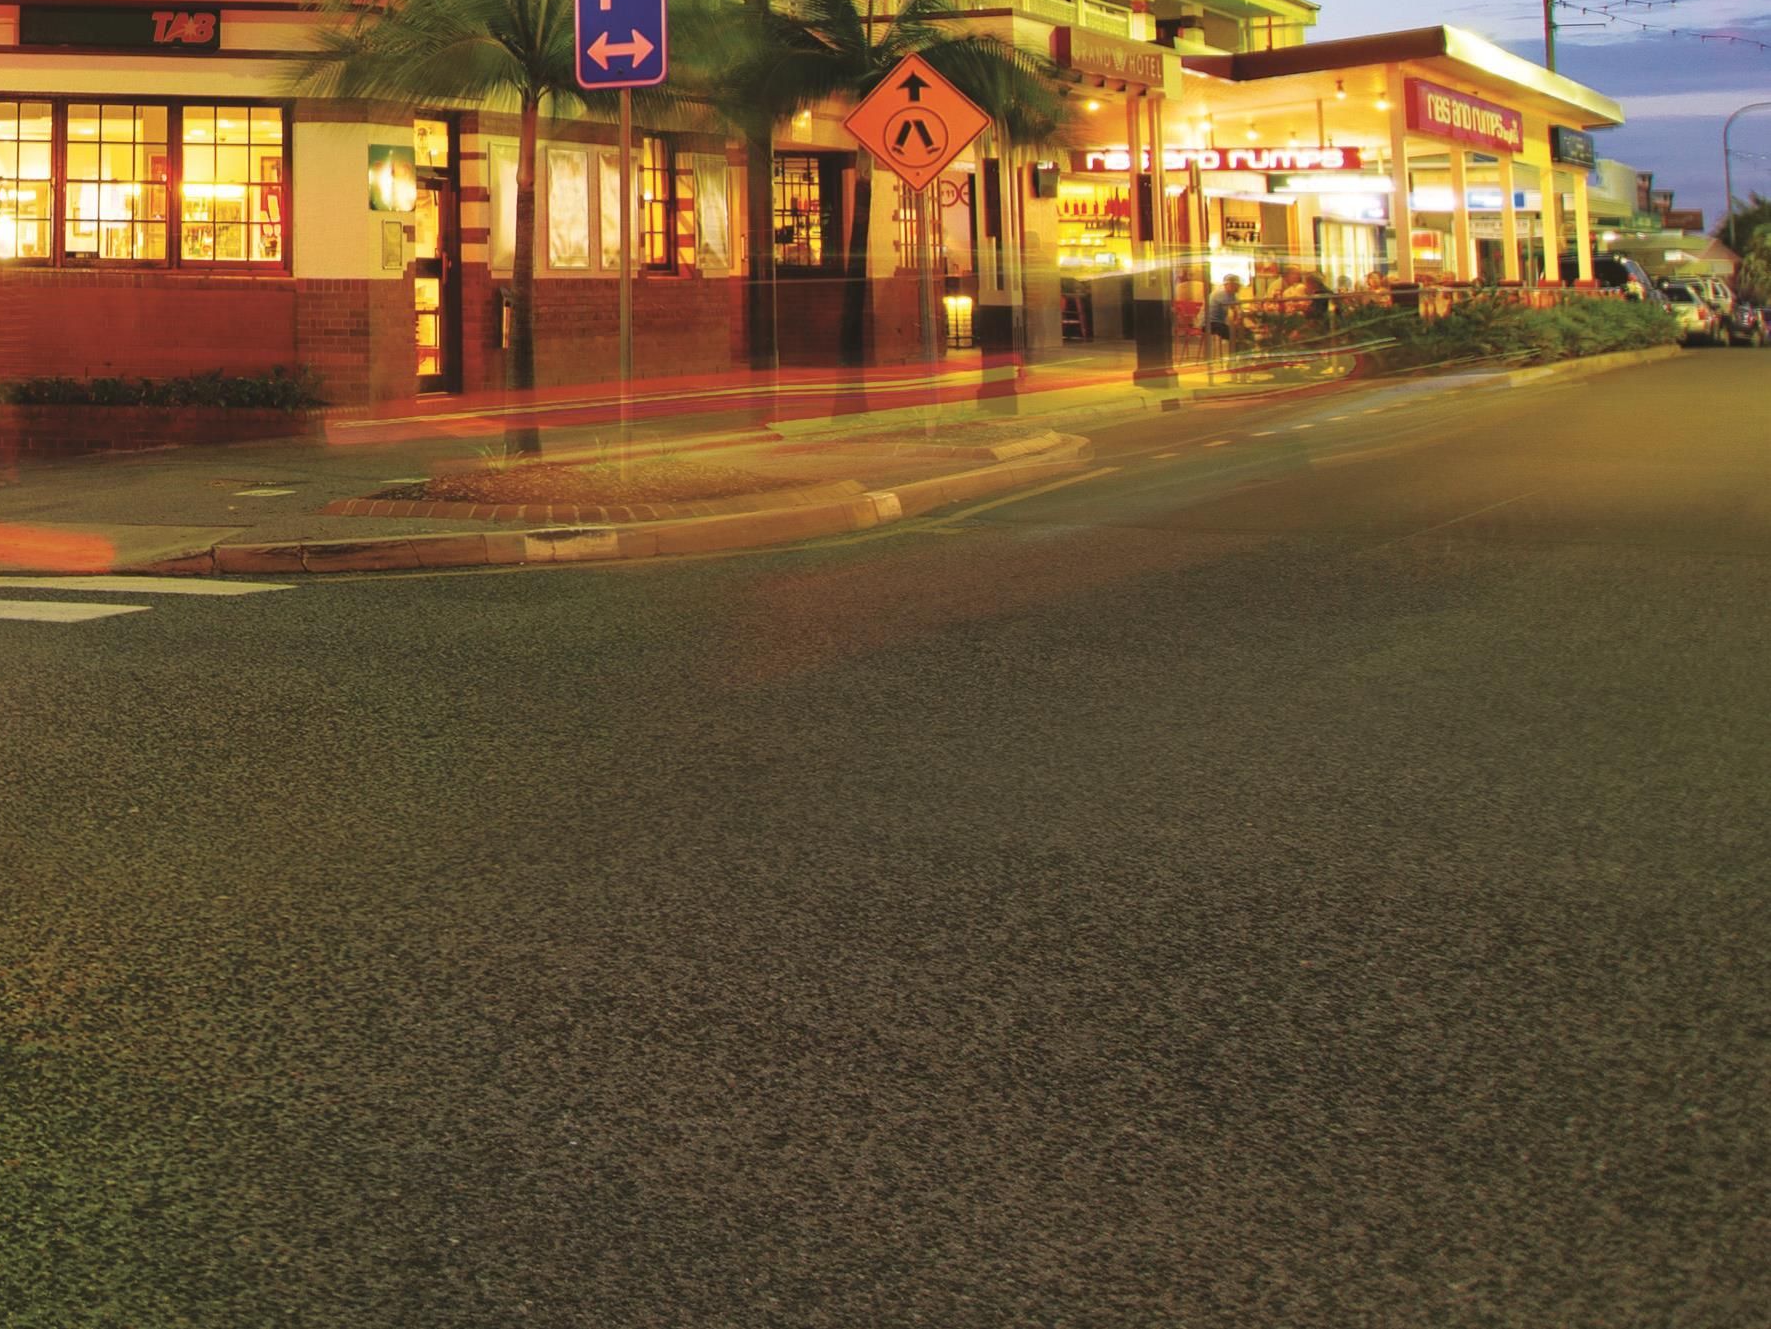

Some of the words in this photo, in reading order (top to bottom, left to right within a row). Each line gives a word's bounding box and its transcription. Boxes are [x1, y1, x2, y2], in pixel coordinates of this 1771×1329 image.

[151, 11, 216, 43] TAB
[1073, 40, 1113, 68] GRAND
[1129, 52, 1162, 79] HOTEL
